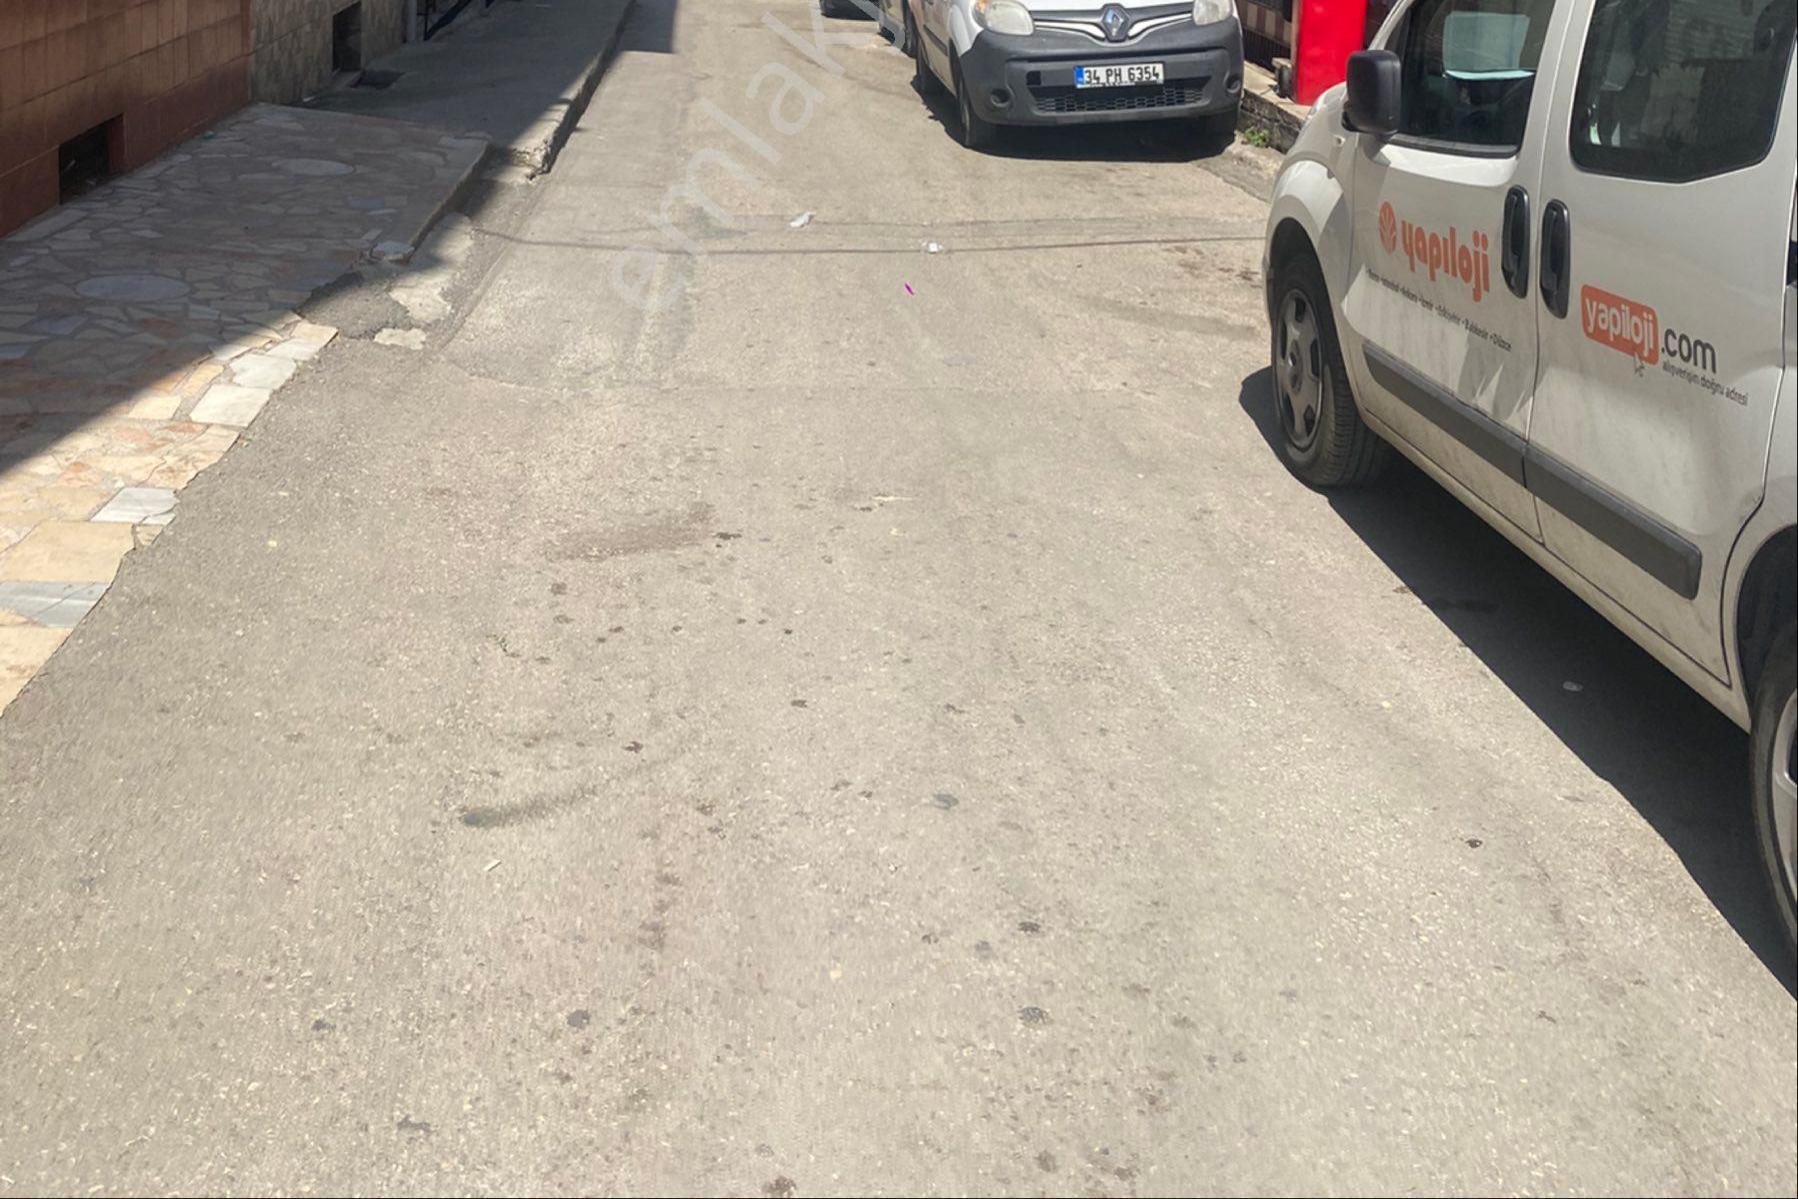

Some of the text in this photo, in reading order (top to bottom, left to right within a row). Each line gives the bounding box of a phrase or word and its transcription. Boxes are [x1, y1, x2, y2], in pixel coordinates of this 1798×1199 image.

[1085, 65, 1159, 84] 34 PH 6354
